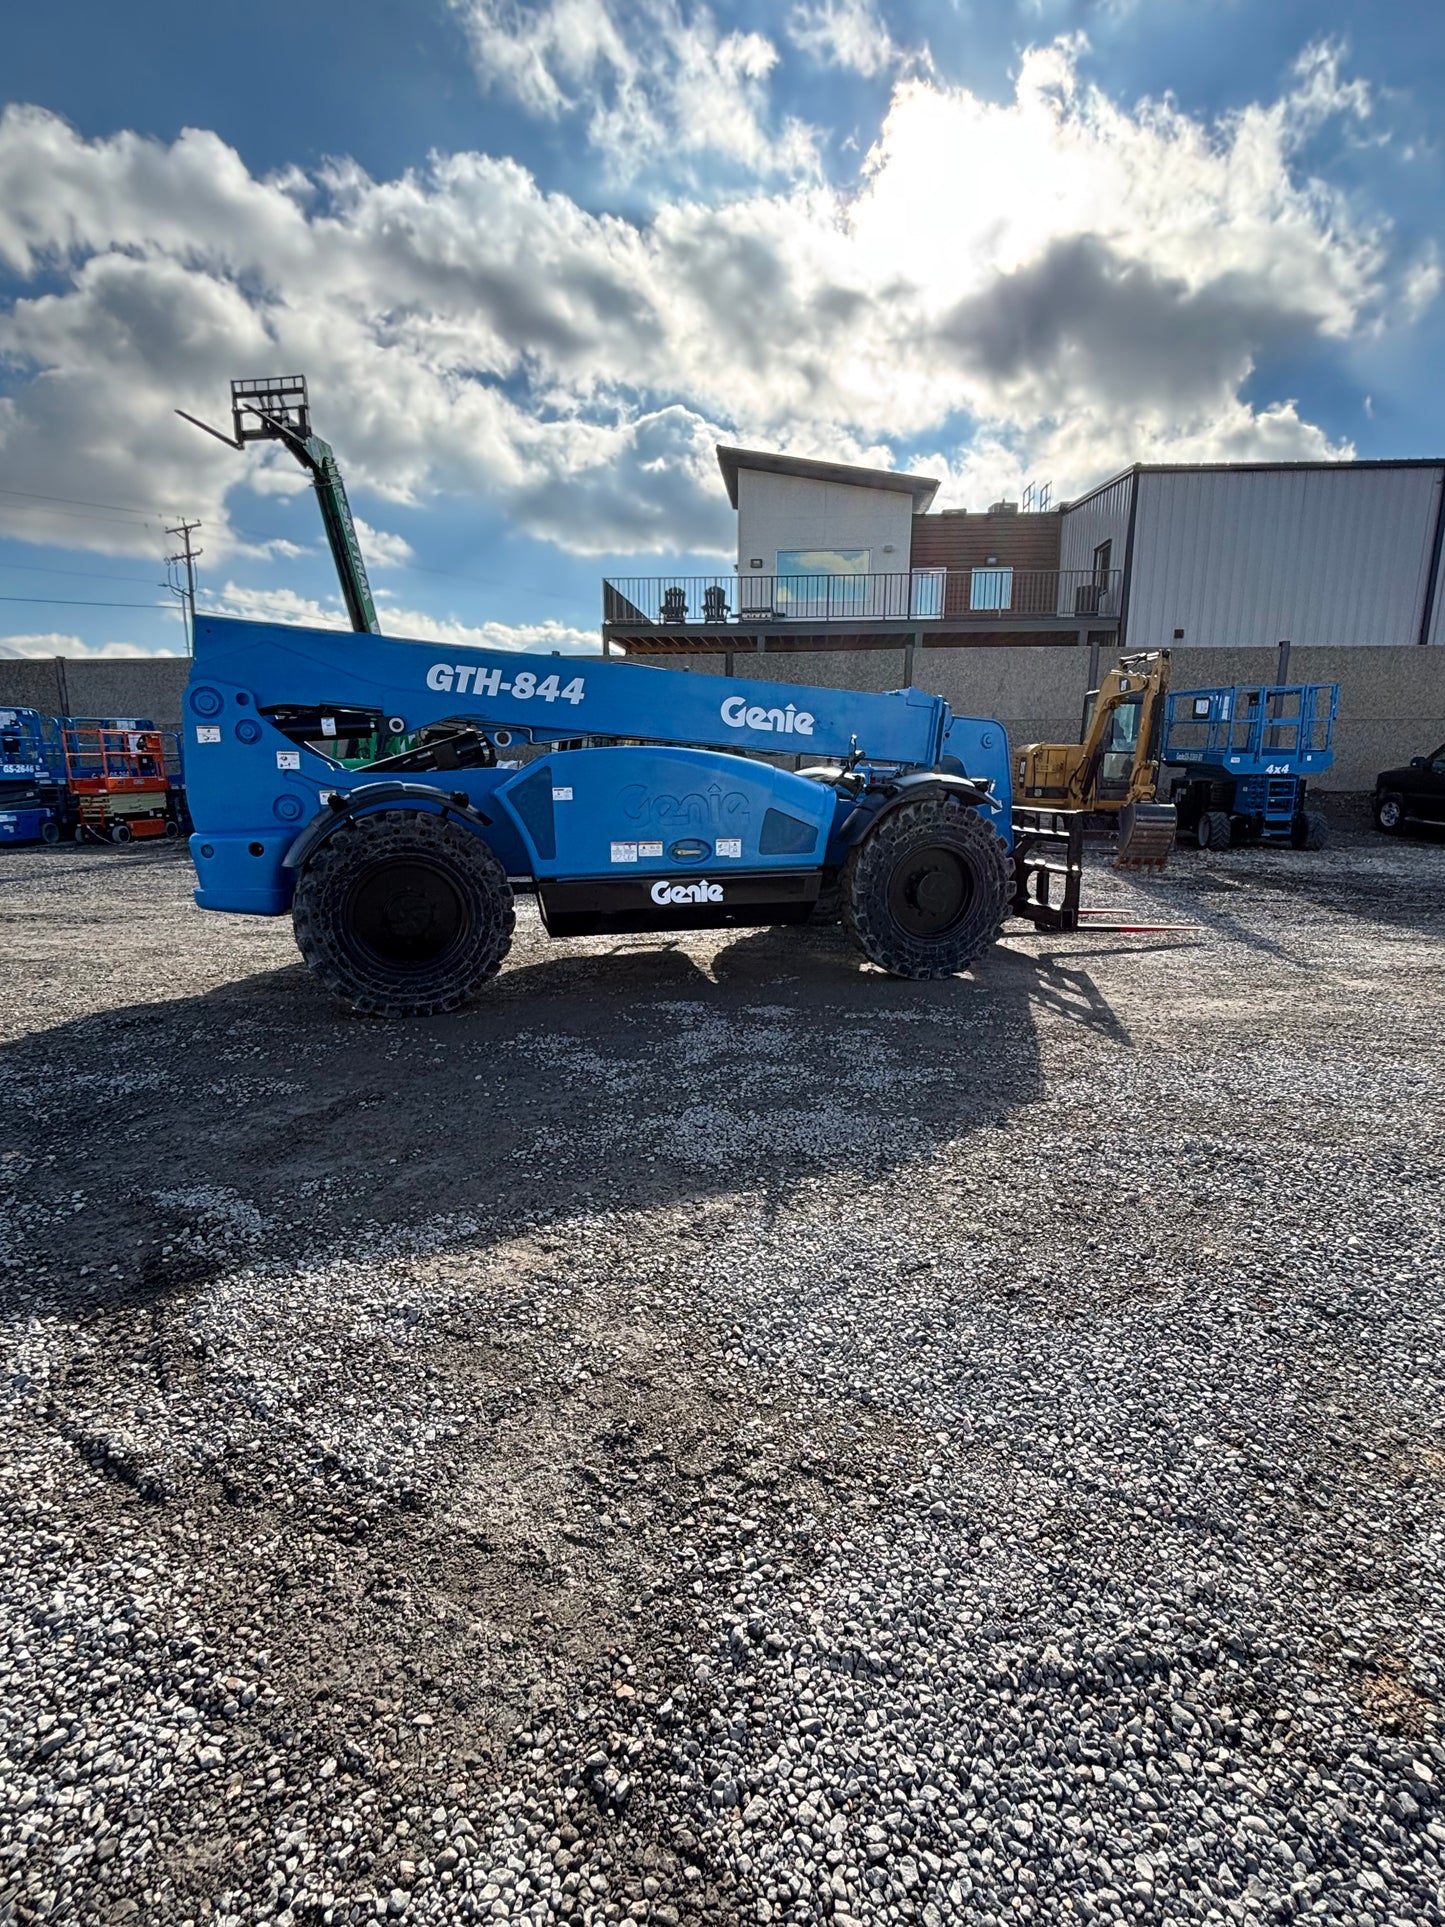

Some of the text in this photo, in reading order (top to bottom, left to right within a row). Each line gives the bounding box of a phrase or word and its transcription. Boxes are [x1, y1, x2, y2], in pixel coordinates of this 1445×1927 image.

[426, 663, 585, 704] GTH-844
[720, 696, 814, 735] Genie
[1265, 764, 1289, 774] 4x4
[616, 783, 750, 828] Genie
[651, 879, 724, 905] Genie
